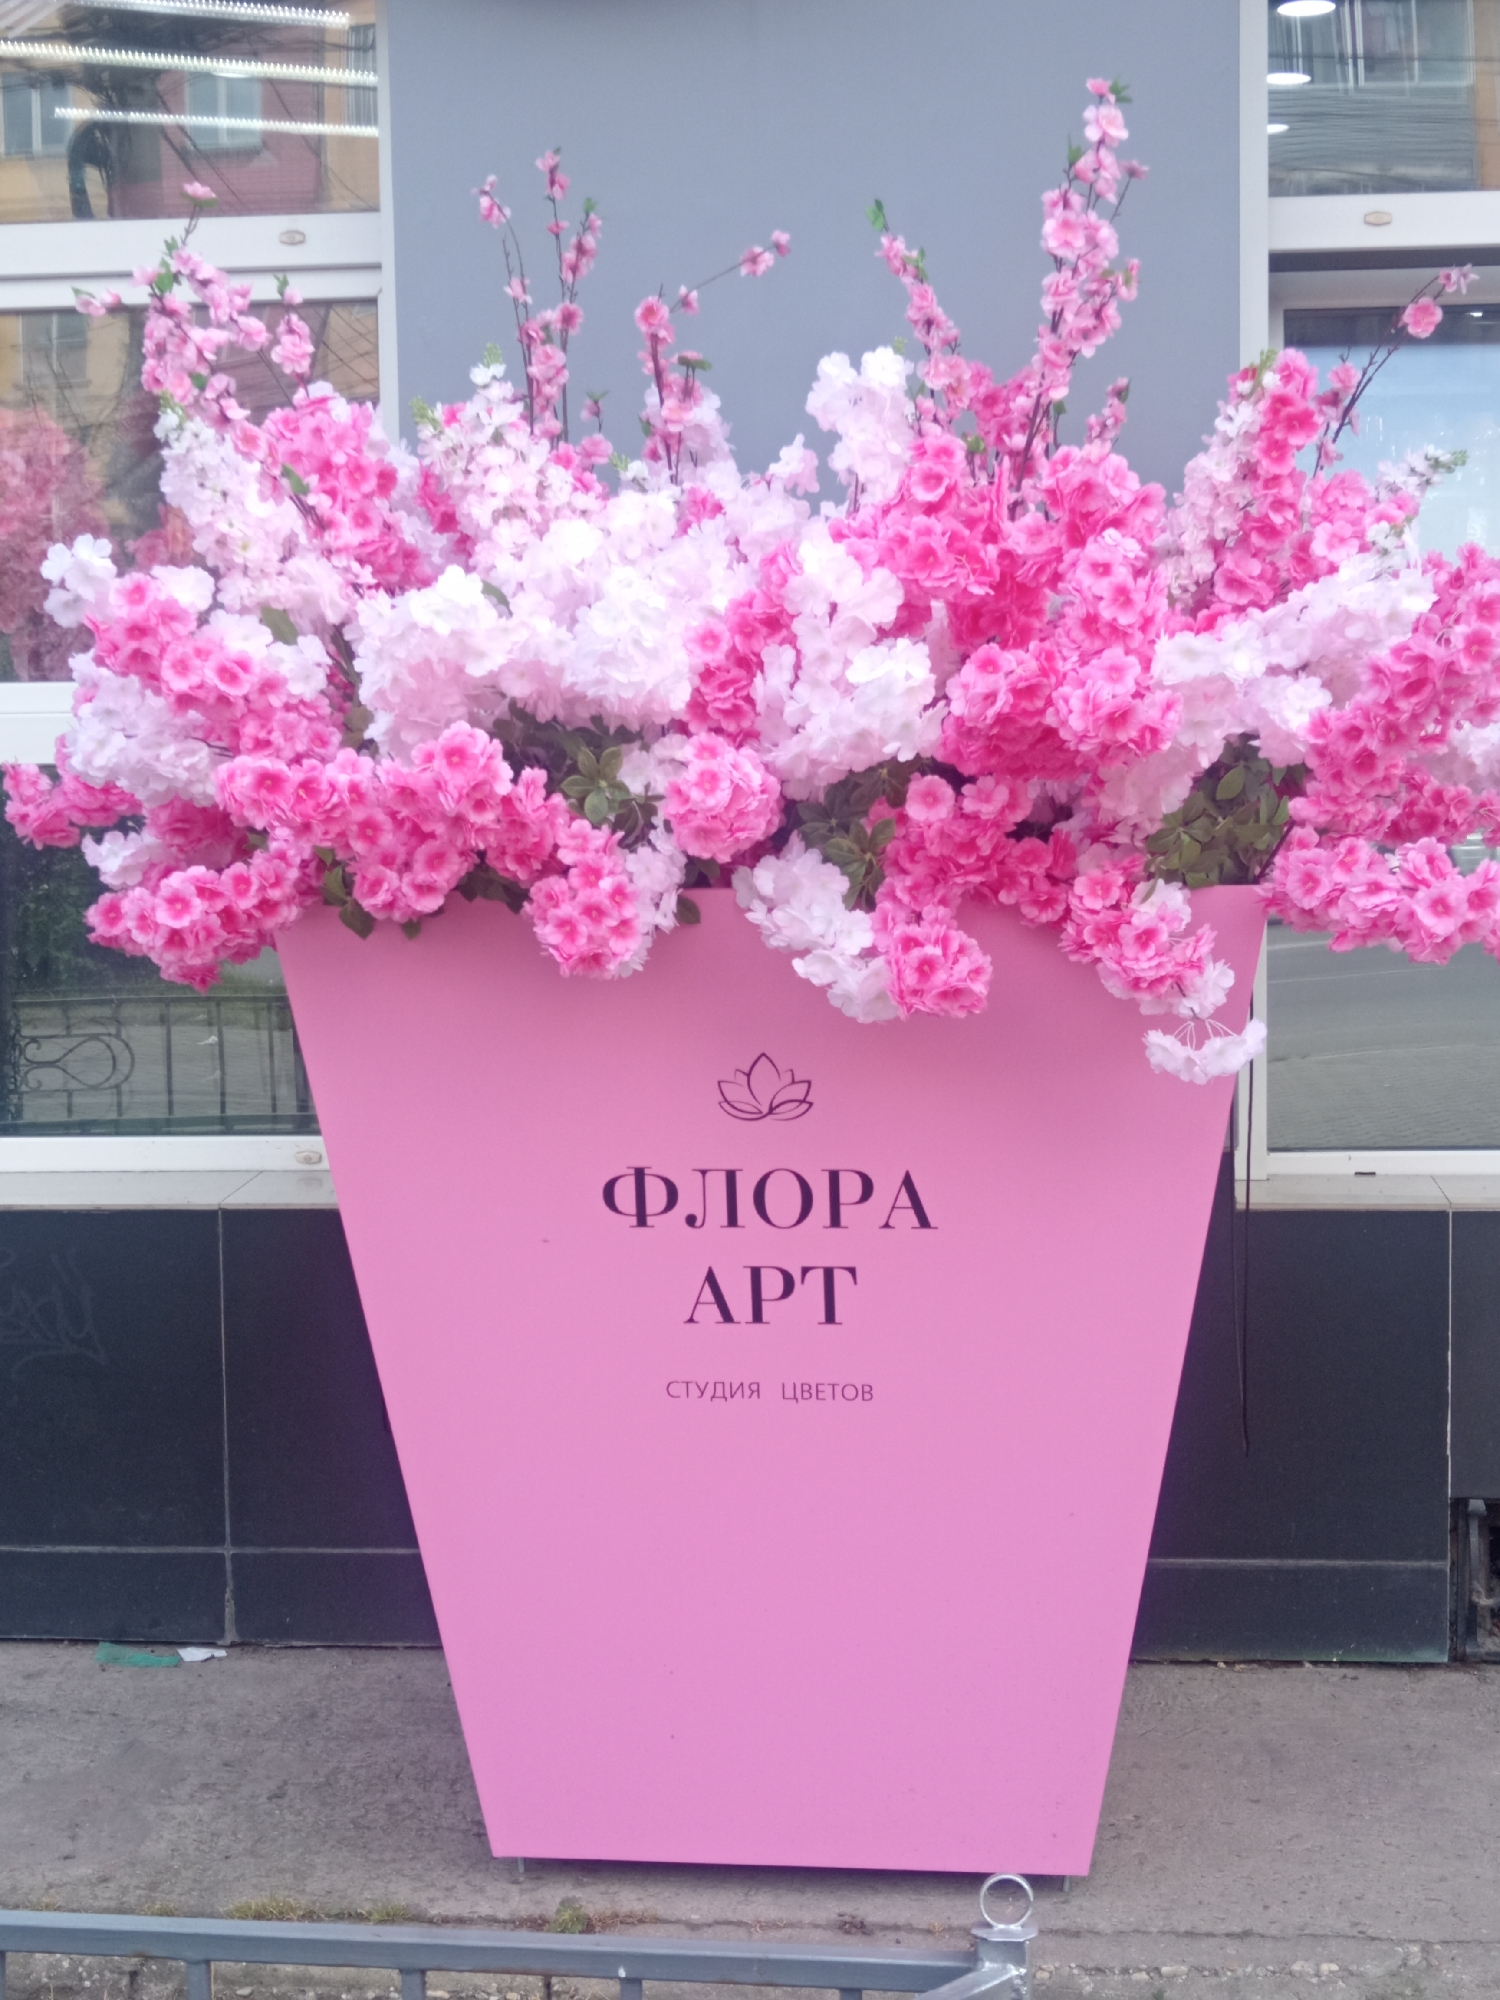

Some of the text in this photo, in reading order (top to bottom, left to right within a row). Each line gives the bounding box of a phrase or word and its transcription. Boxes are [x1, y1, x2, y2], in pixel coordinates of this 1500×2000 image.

[602, 1166, 938, 1230] ФЛОРА
[683, 1265, 858, 1325] АРТ
[666, 1380, 874, 1404] СТУДИЯ ЦВЕТОВ
